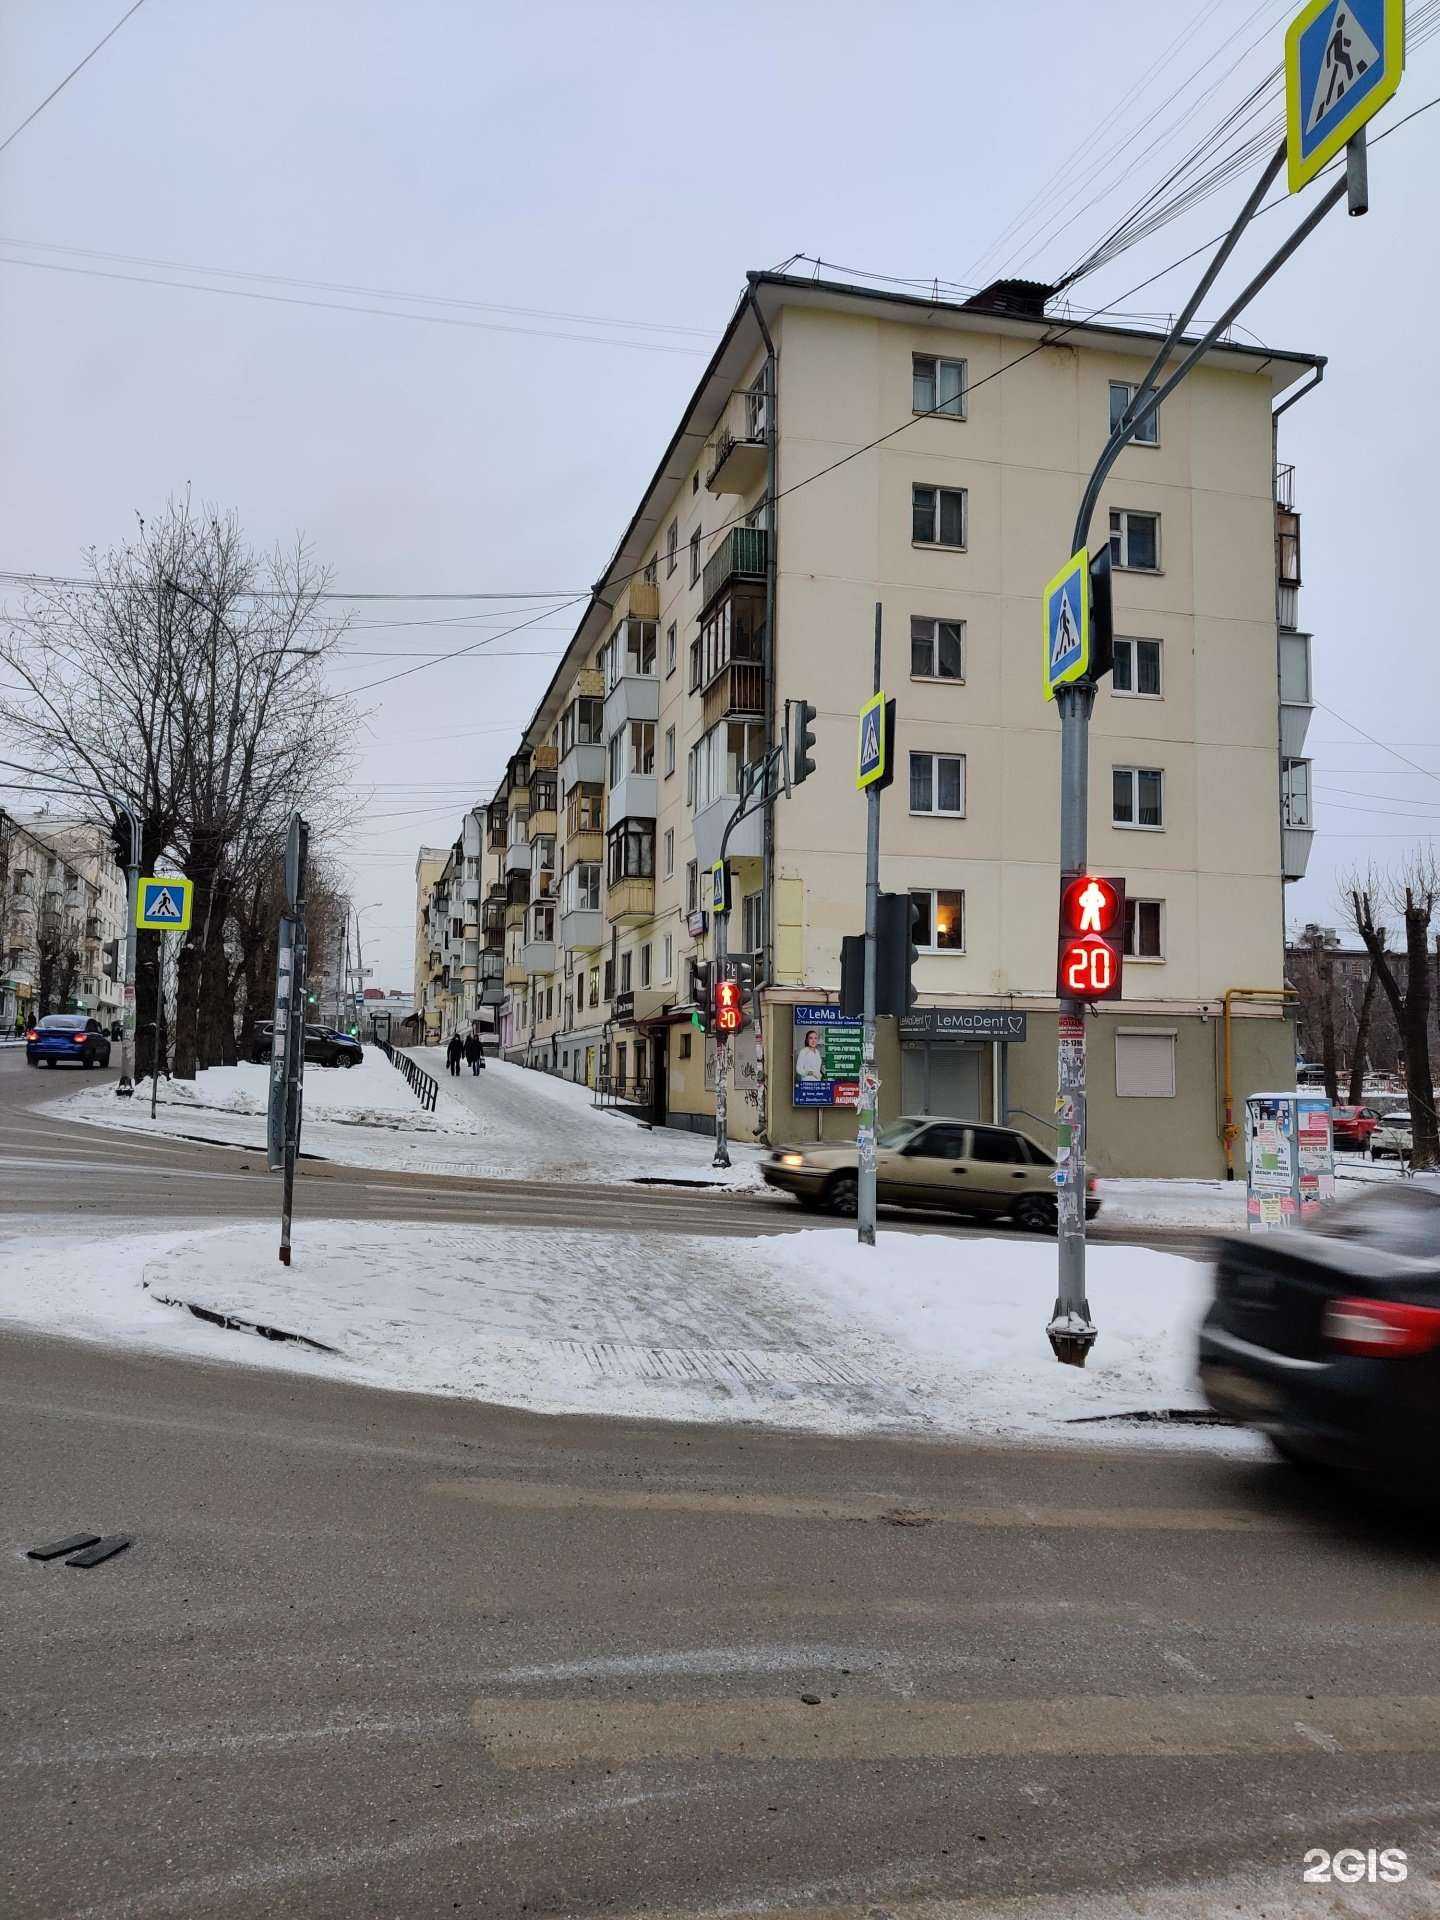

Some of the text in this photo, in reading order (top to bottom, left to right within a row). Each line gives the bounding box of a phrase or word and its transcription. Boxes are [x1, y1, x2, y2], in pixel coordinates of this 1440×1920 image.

[1068, 948, 1110, 989] 20
[720, 1011, 736, 1028] 20
[809, 1009, 836, 1020] LeMa
[937, 1014, 1003, 1028] LeMaDent
